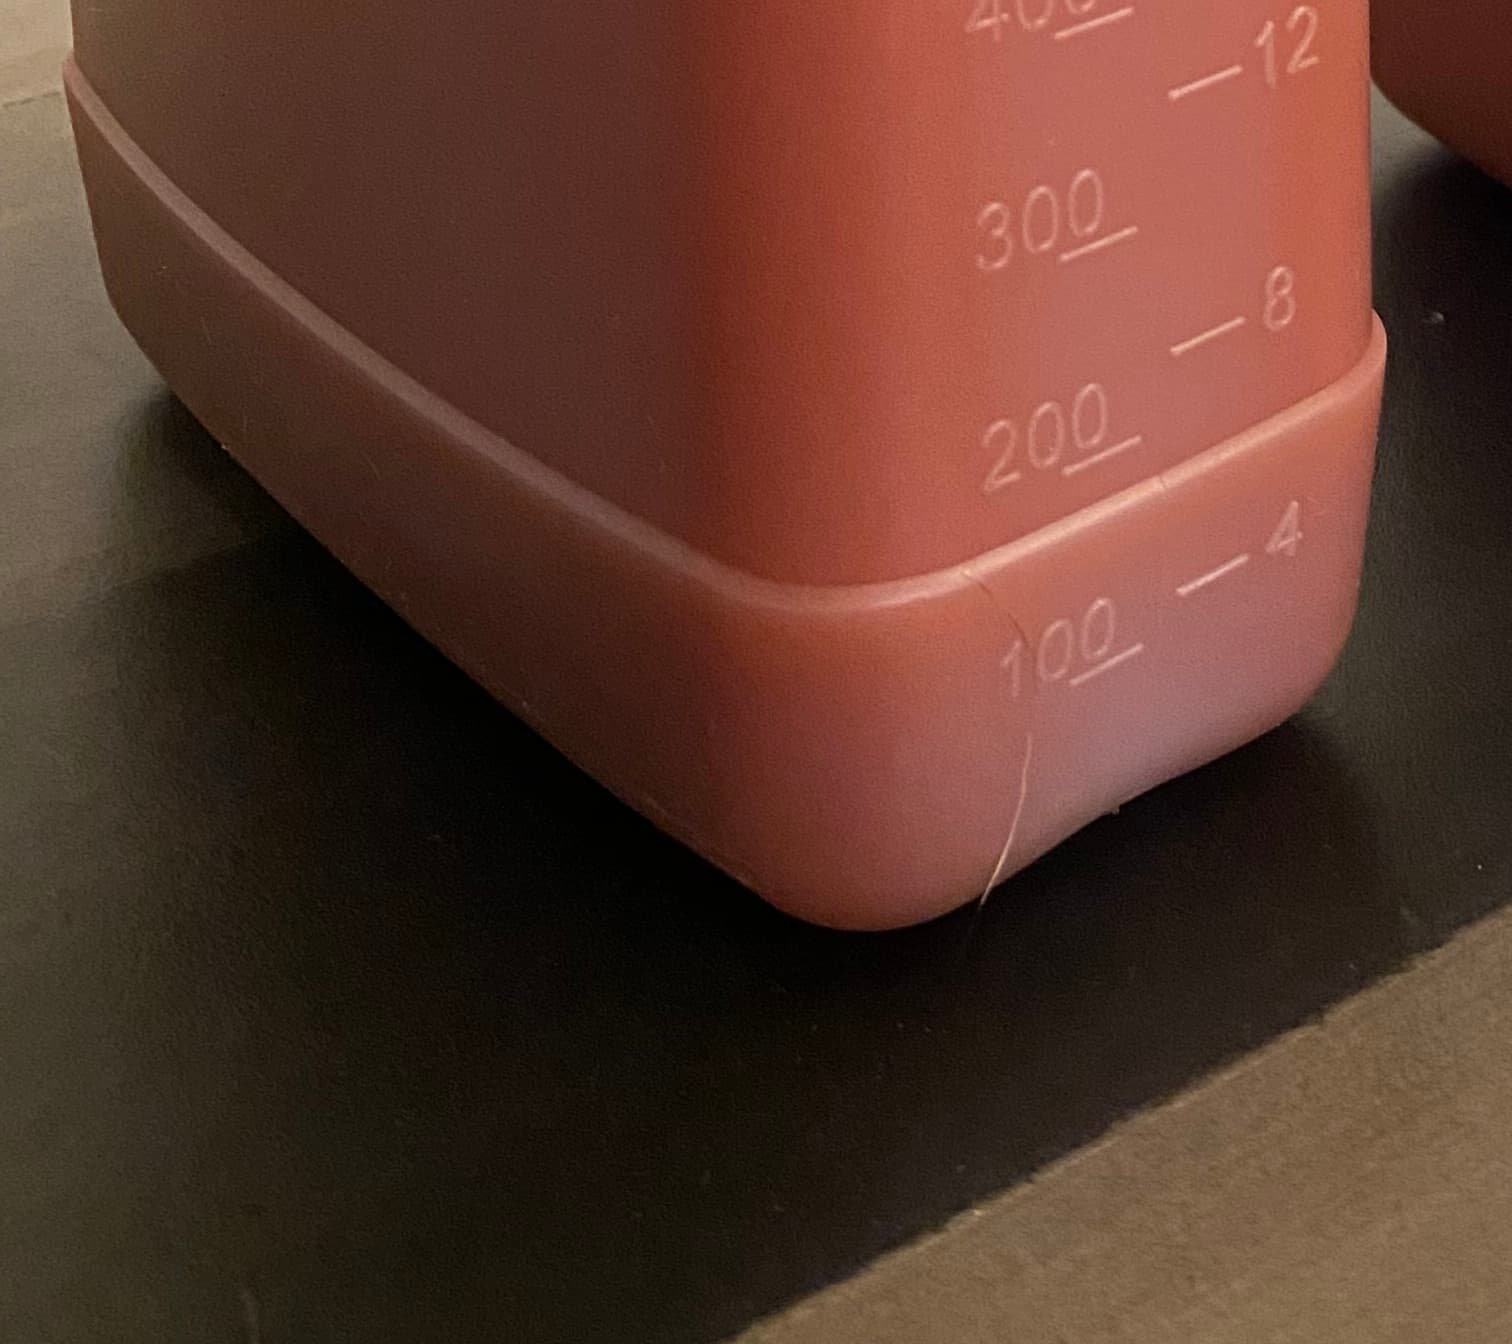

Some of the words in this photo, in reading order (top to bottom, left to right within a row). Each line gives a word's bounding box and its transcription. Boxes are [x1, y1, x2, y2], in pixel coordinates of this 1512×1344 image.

[1253, 5, 1320, 89] 12
[975, 168, 1104, 272] 300
[1262, 265, 1297, 332] 8
[981, 382, 1107, 496] 200
[1264, 500, 1304, 558] 4
[1000, 597, 1116, 698] 100
